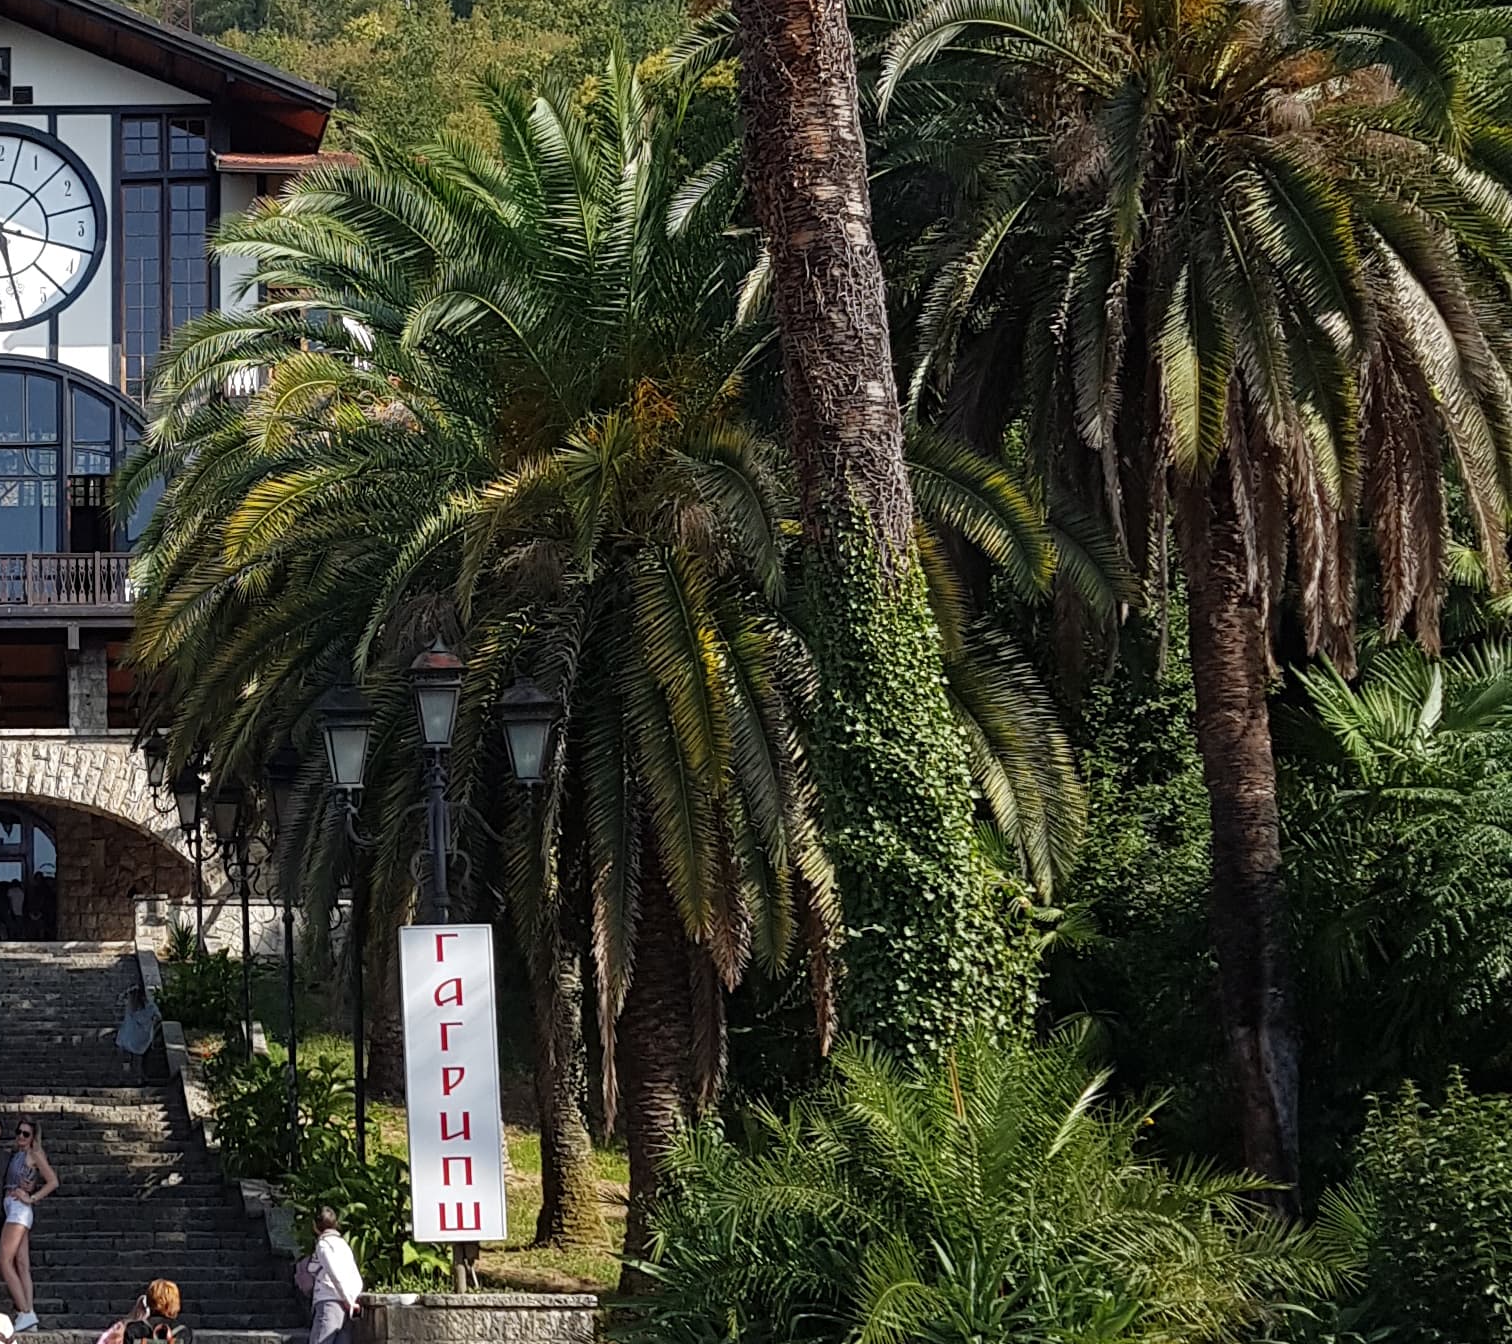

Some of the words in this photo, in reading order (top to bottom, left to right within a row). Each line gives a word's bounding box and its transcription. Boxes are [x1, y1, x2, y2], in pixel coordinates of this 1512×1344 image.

[64, 180, 72, 197] 2
[77, 220, 85, 237] 3
[65, 258, 74, 274] 4
[40, 286, 47, 304] 5
[433, 933, 481, 1231] ГАГРИПШ
